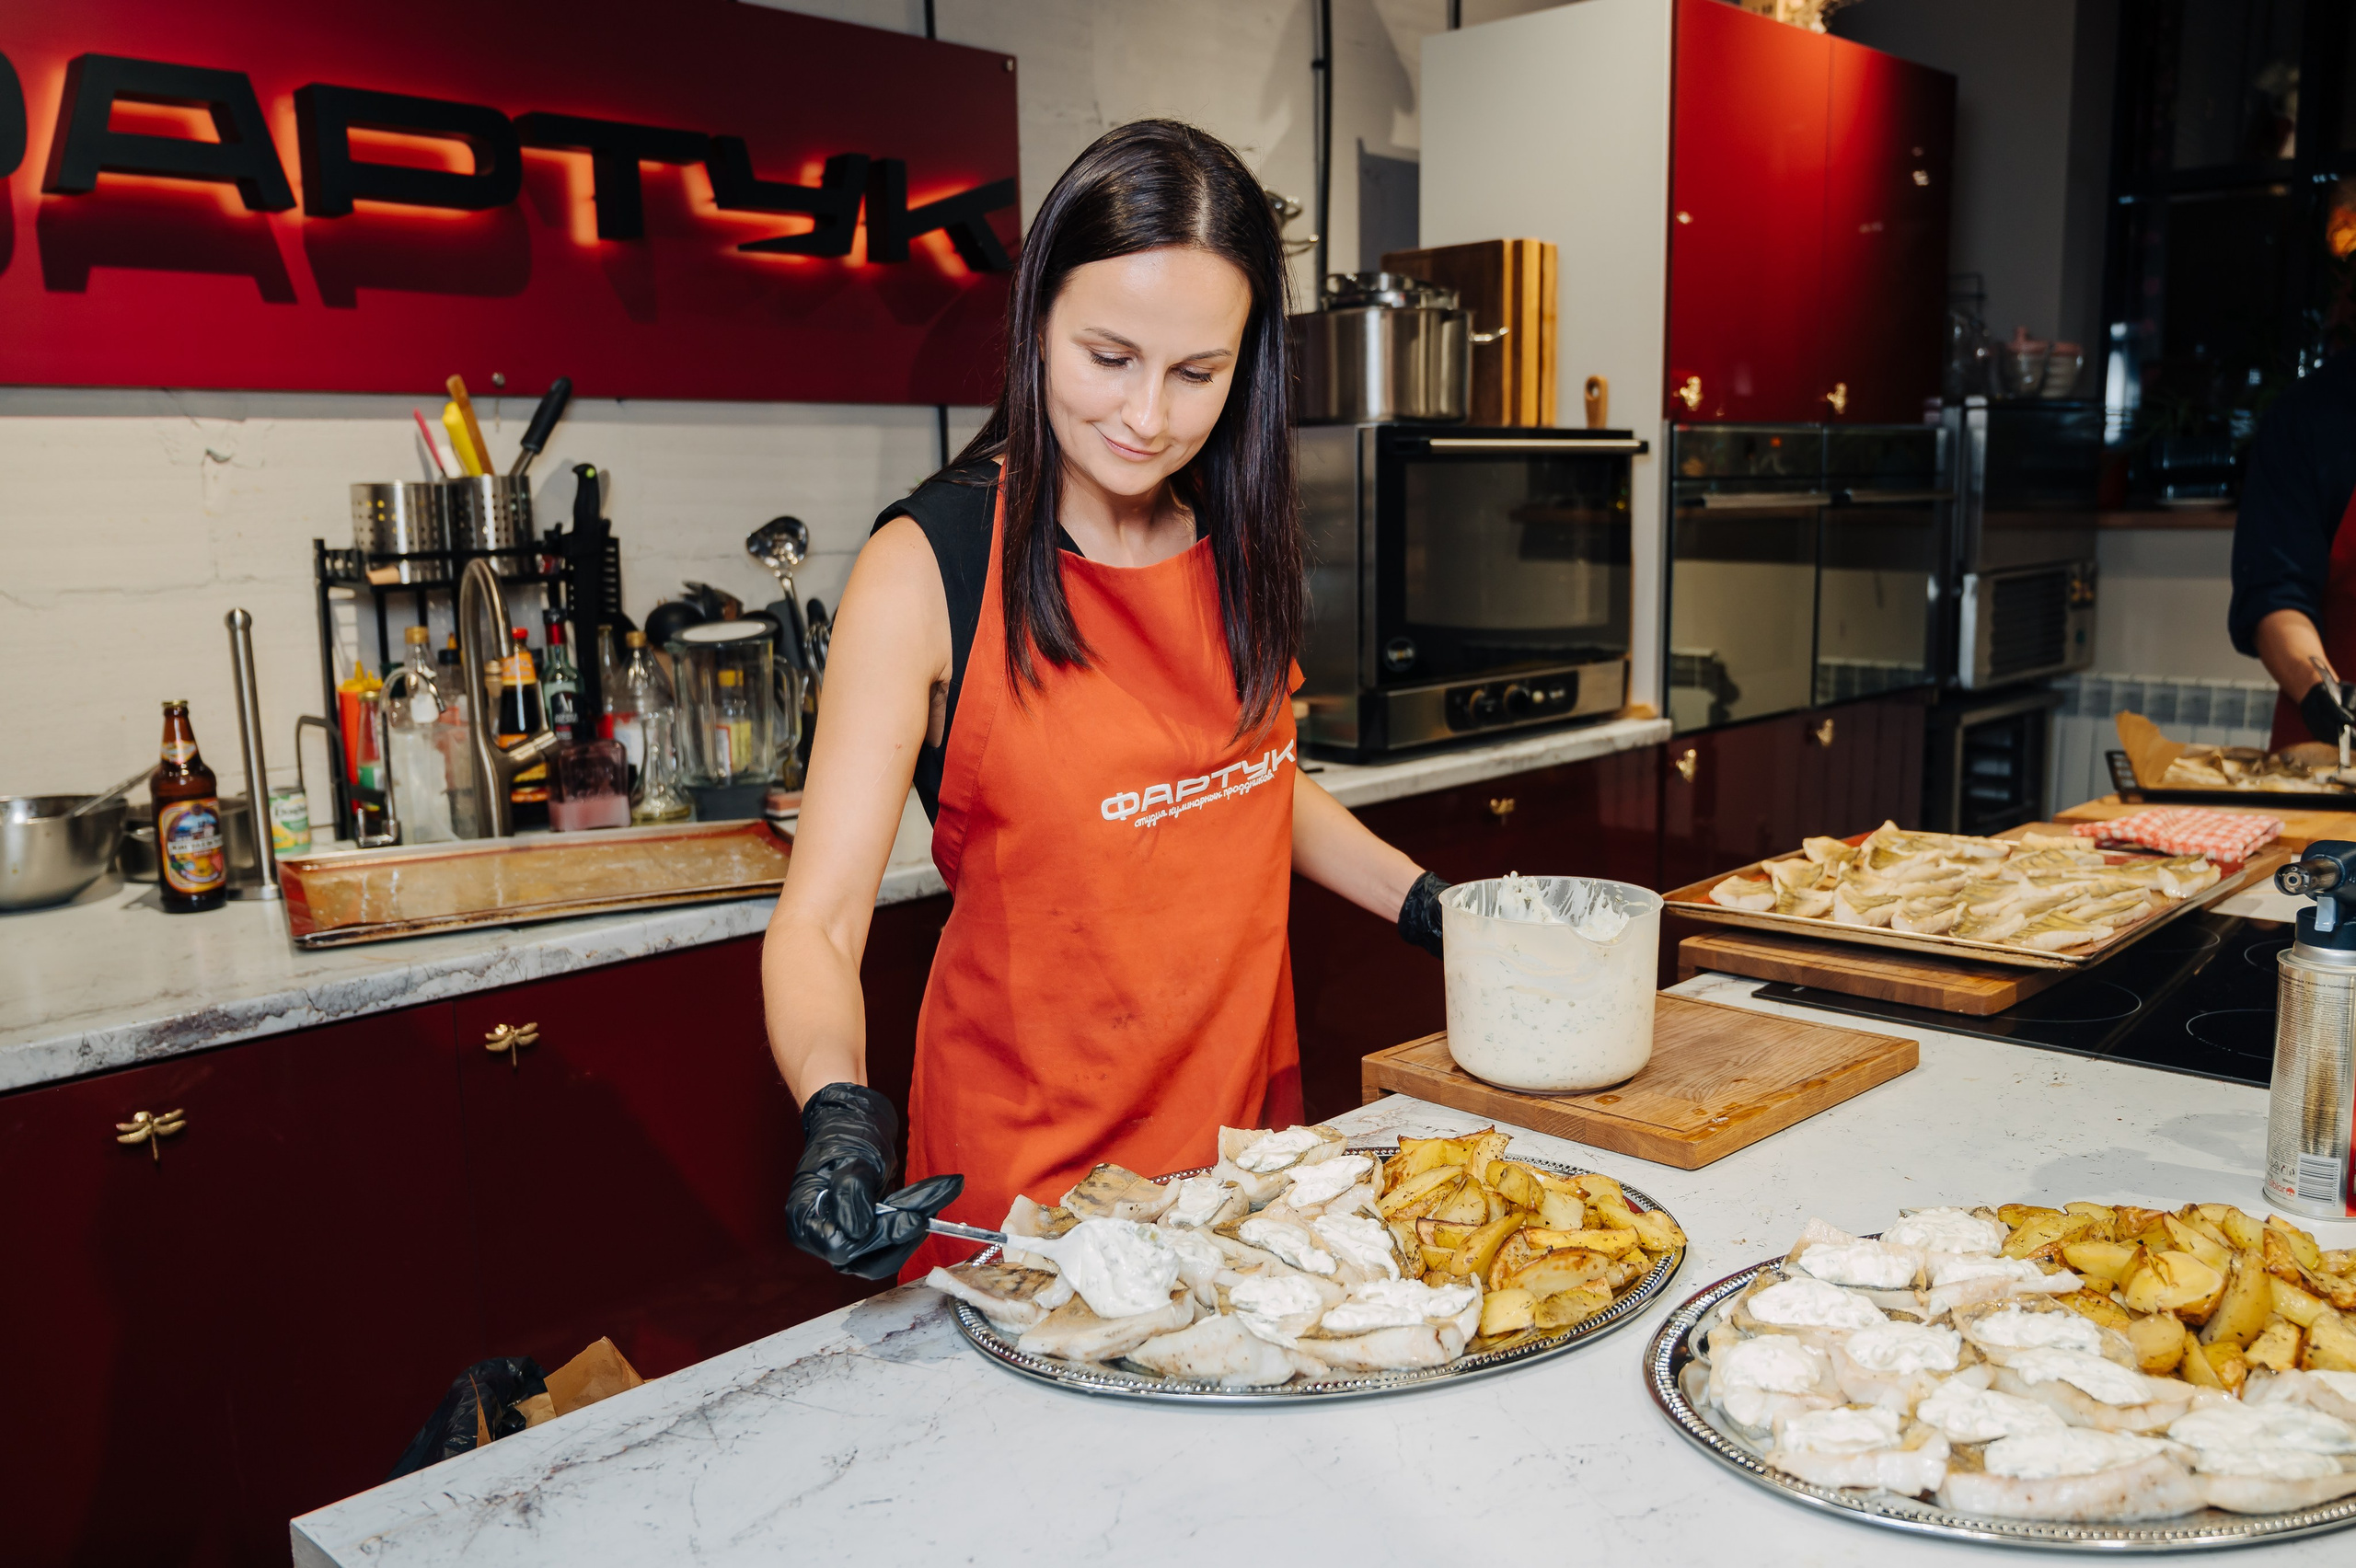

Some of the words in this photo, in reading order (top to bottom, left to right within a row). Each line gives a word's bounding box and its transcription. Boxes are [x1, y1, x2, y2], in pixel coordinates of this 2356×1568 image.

[0, 51, 1016, 272] АРТУК
[1101, 738, 1296, 821] ФАРТУК
[1134, 809, 1167, 828] студия
[1168, 790, 1223, 819] кулинарных
